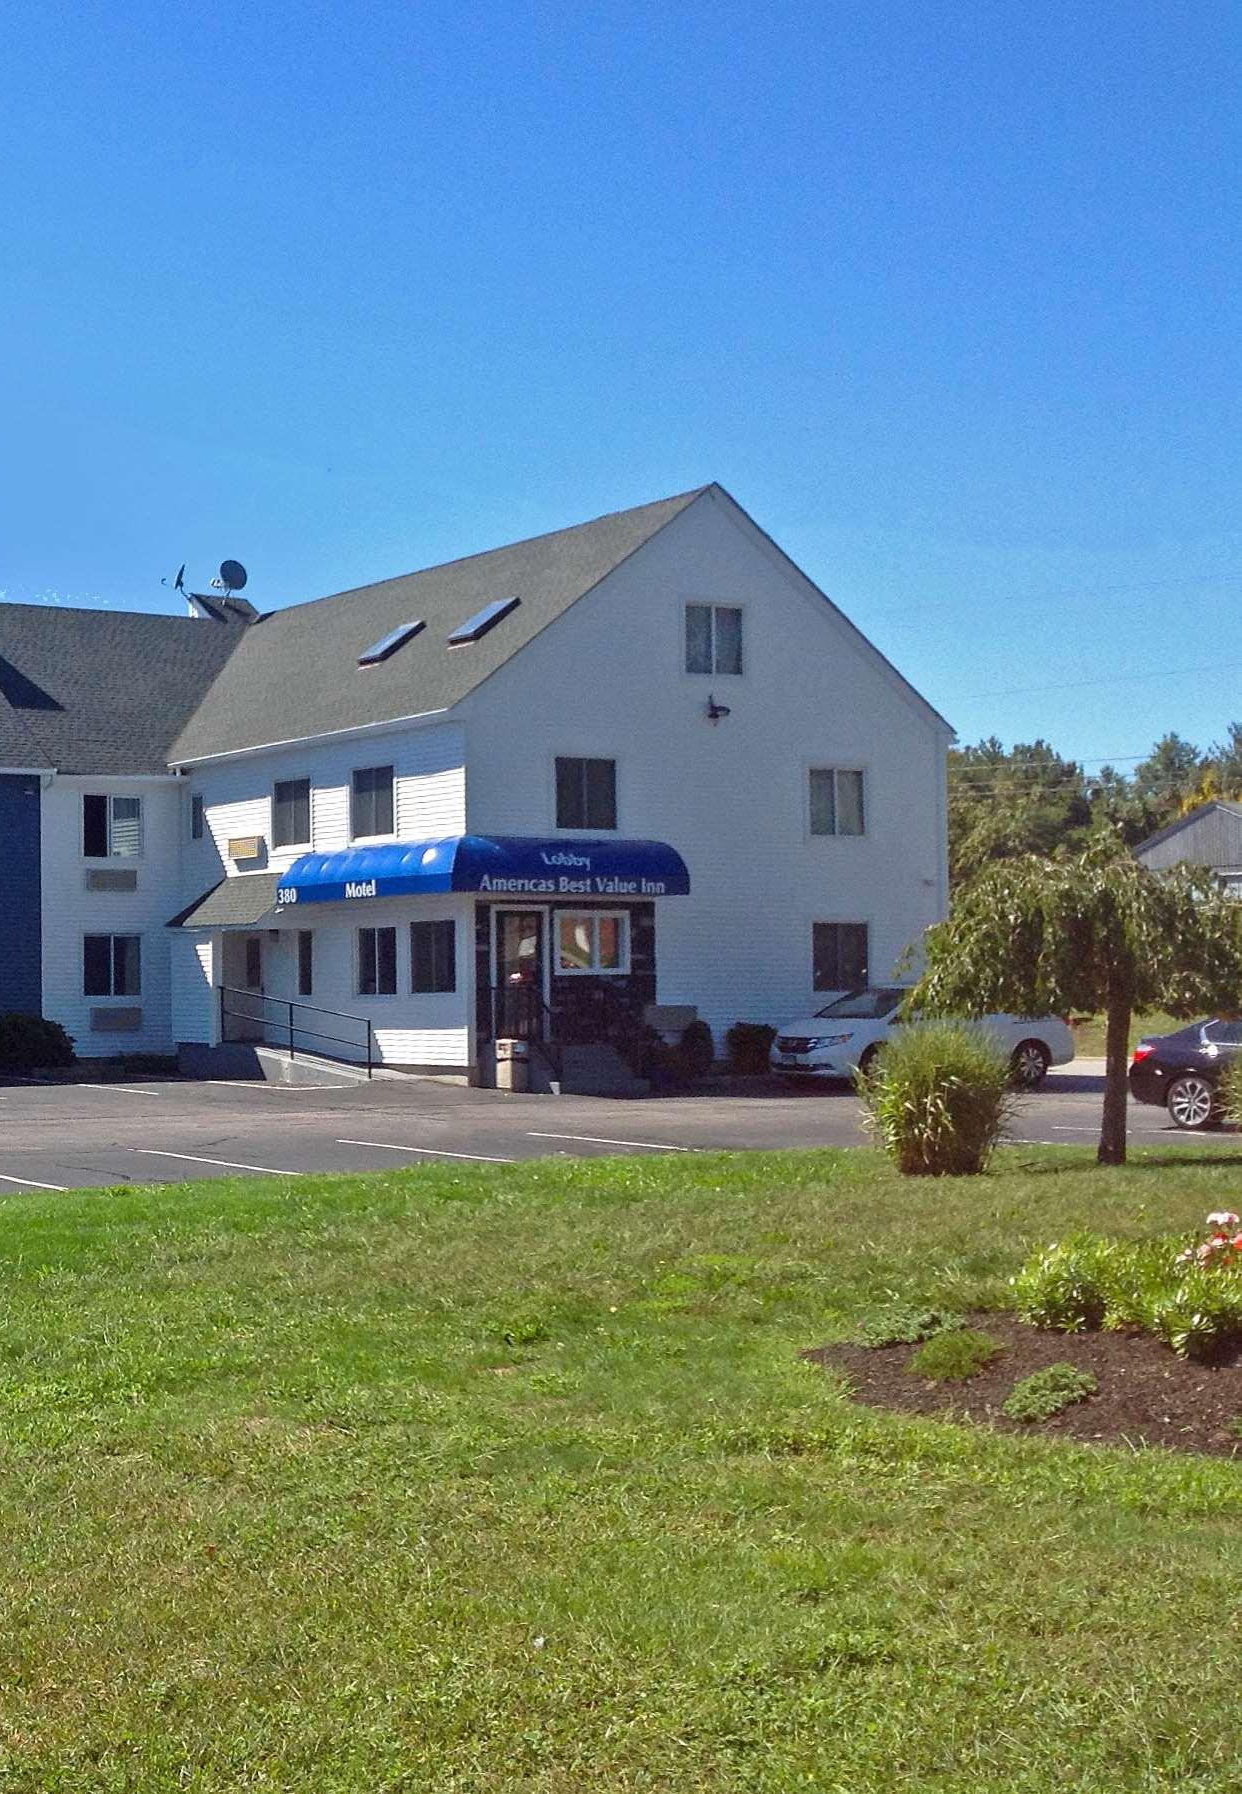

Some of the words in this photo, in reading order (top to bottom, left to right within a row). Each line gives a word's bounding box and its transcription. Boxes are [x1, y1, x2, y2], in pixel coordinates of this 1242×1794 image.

[541, 852, 591, 871] Lobby
[345, 880, 376, 899] Motel
[479, 874, 555, 892] Americas
[559, 876, 592, 892] Best
[595, 877, 637, 893] Value
[641, 878, 665, 894] Inn
[278, 888, 297, 904] 380
